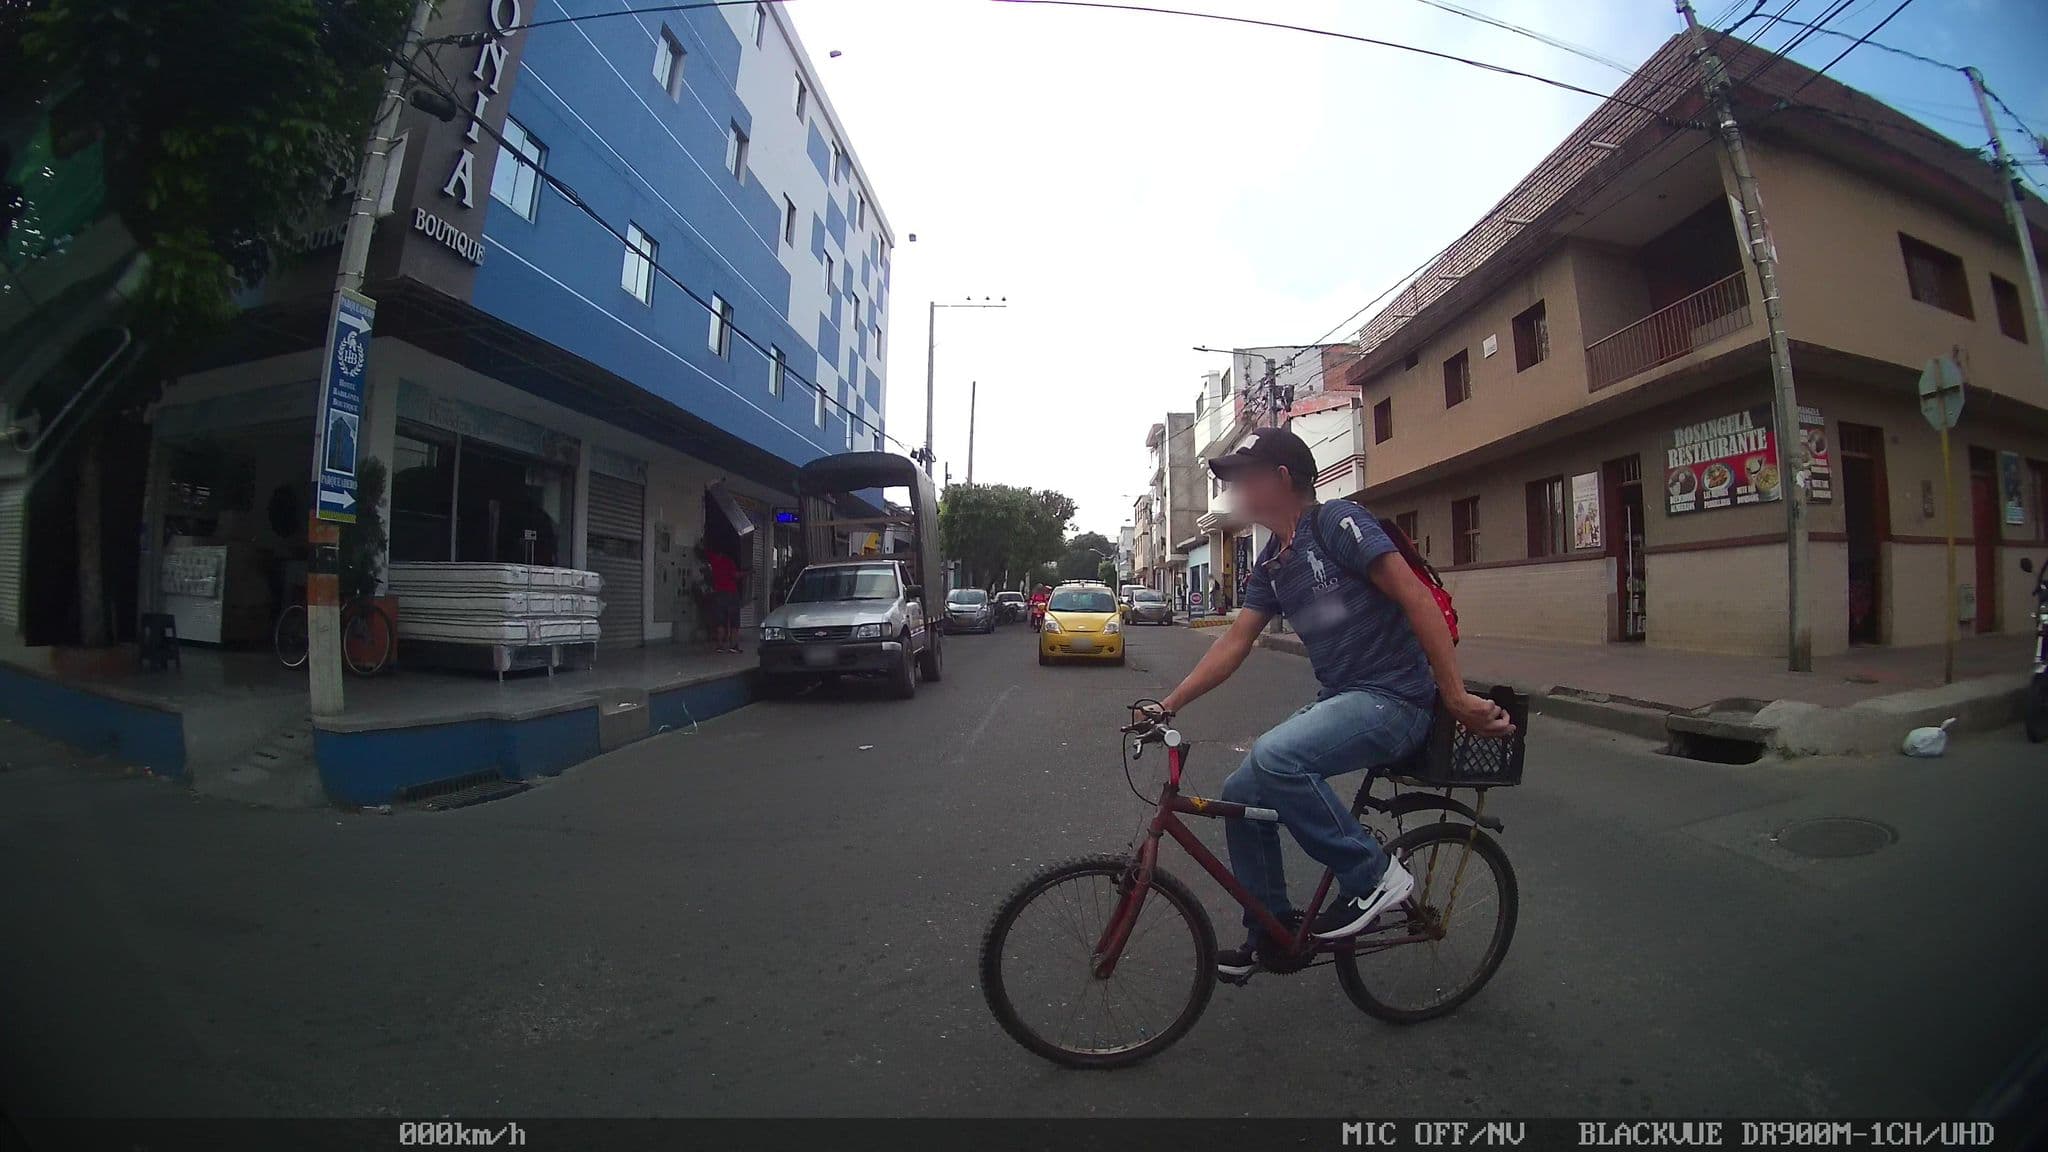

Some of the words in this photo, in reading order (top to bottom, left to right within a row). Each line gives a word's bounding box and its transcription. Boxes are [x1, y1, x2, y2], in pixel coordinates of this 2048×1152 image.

[414, 207, 486, 267] BOUTIQUE
[1668, 427, 1768, 469] RESTAURANTE
[1674, 410, 1754, 448] ROSANGELA
[1340, 516, 1364, 543] 7
[1312, 577, 1338, 592] POLO
